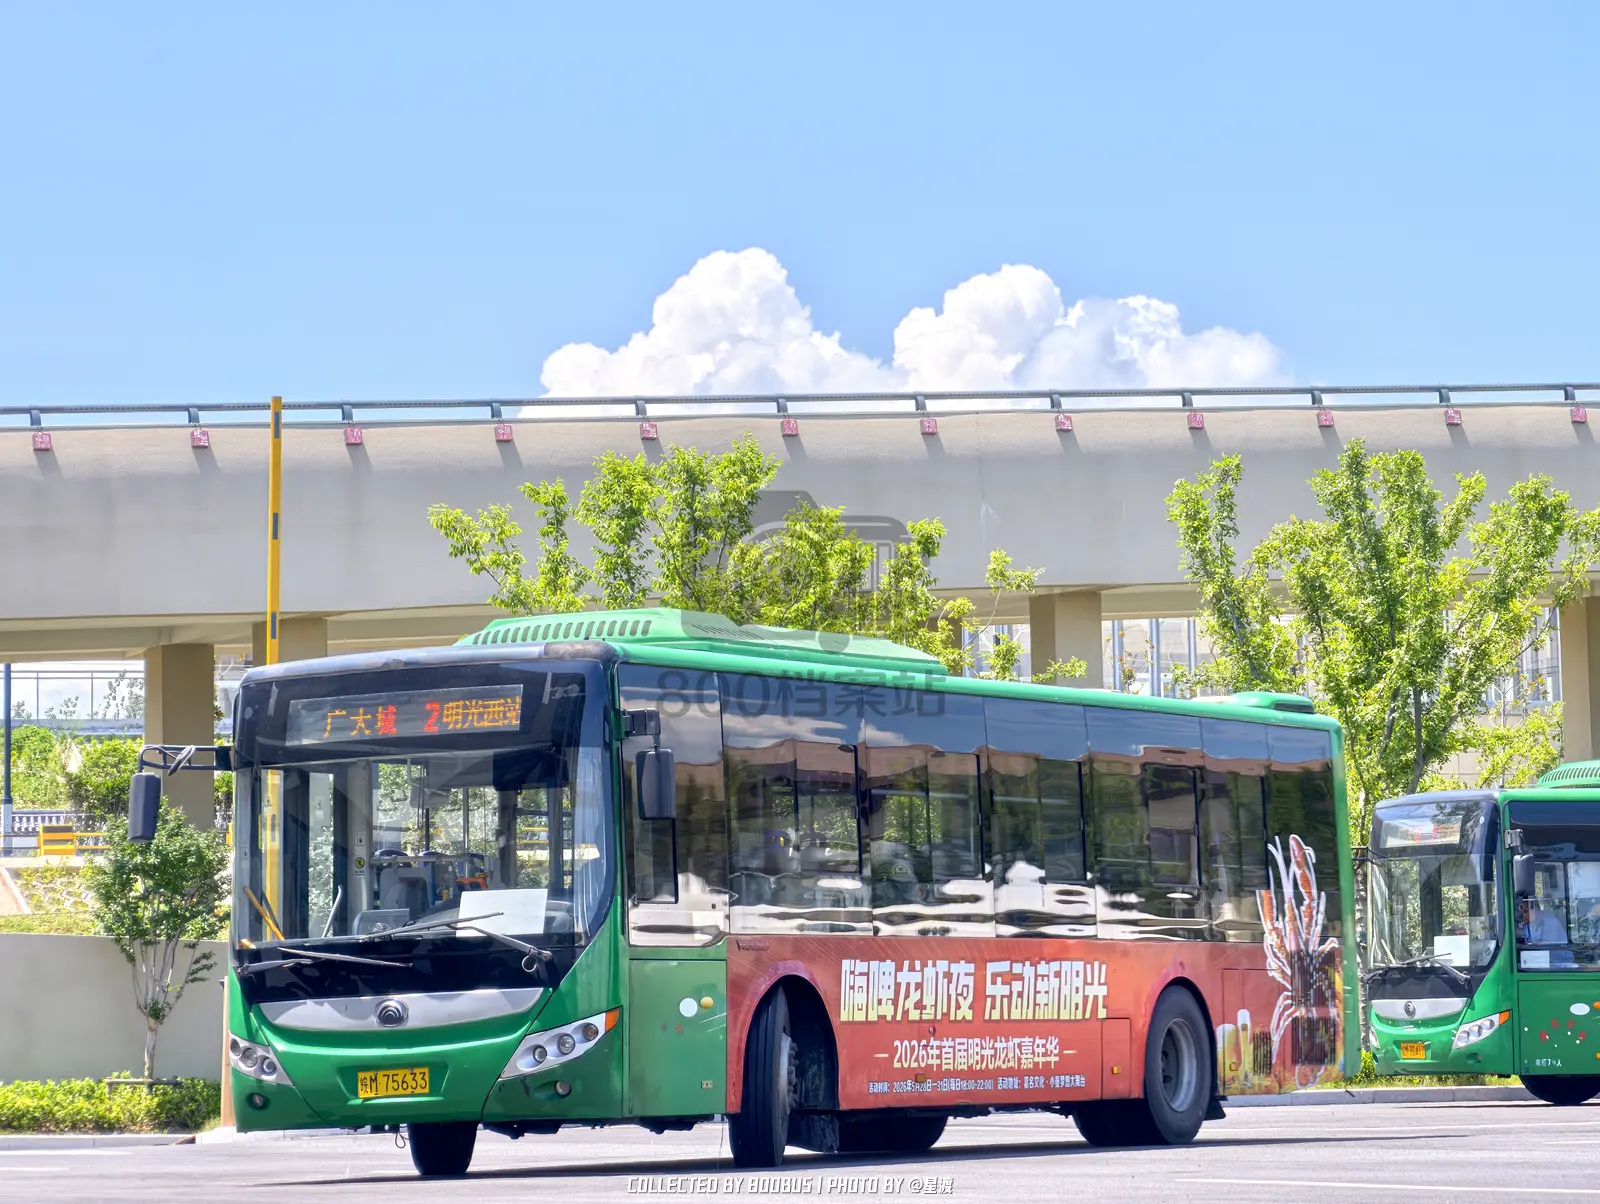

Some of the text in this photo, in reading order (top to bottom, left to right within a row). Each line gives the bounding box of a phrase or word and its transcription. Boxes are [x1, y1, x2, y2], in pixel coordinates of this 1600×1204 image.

[424, 701, 440, 733] 2
[442, 696, 520, 729] 明光西站
[840, 959, 1108, 1022] 嗨啤龙虾夜 乐动新明光
[893, 1036, 1060, 1071] 2026年首届明光龙虾嘉年华
